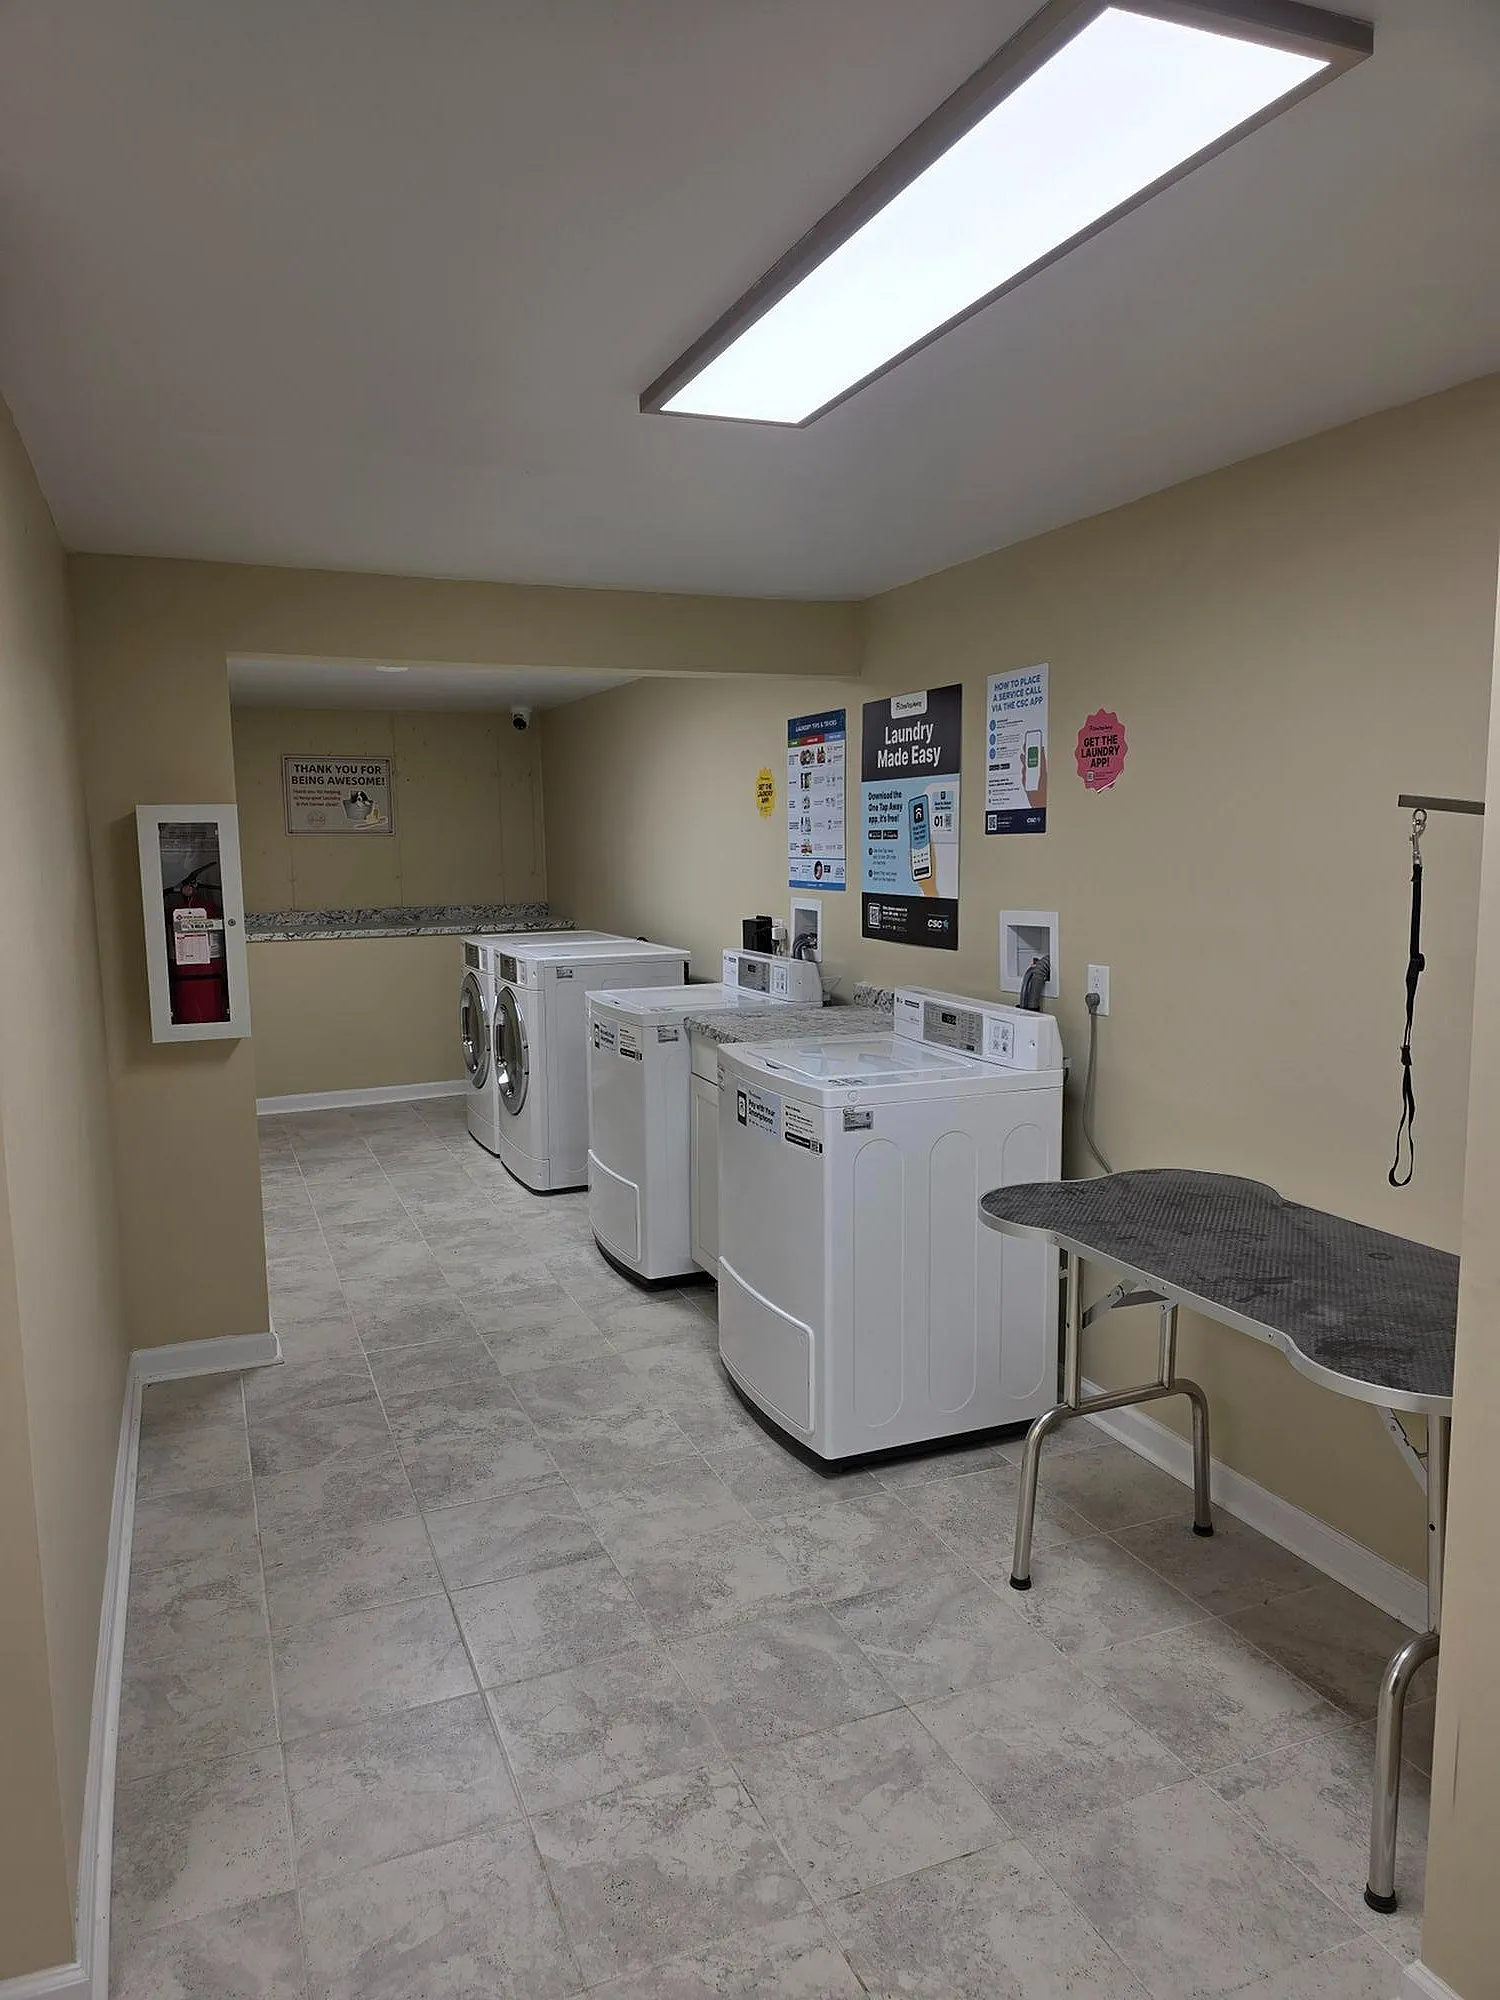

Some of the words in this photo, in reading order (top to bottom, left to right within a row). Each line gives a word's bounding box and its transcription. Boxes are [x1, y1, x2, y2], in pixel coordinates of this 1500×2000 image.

[994, 681, 1009, 691] HOW
[1011, 680, 1019, 688] TO
[1020, 674, 1040, 686] PLACE
[999, 689, 1024, 701] SERVICE
[1025, 686, 1042, 695] CALL
[991, 703, 1002, 712] VIA
[1004, 701, 1015, 710] THE
[1016, 698, 1029, 708] CSC
[1030, 696, 1043, 705] APP
[885, 721, 933, 745] Laundry
[1084, 736, 1100, 747] GET
[1101, 735, 1118, 746] THE
[877, 747, 908, 768] Made
[912, 745, 941, 767] Easy
[1081, 745, 1120, 758] LAUNDRY
[1090, 757, 1110, 768] APP!
[294, 764, 332, 774] THANK
[335, 765, 358, 774] YOU
[361, 766, 381, 774] FOR
[292, 776, 324, 785] BEING
[327, 776, 385, 785] AWESOME!
[868, 792, 892, 800] Download
[893, 791, 902, 799] the
[868, 803, 878, 812] One
[879, 803, 888, 812] Tap
[889, 802, 902, 812] Away
[934, 816, 943, 827] 01
[927, 919, 942, 928] CSC
